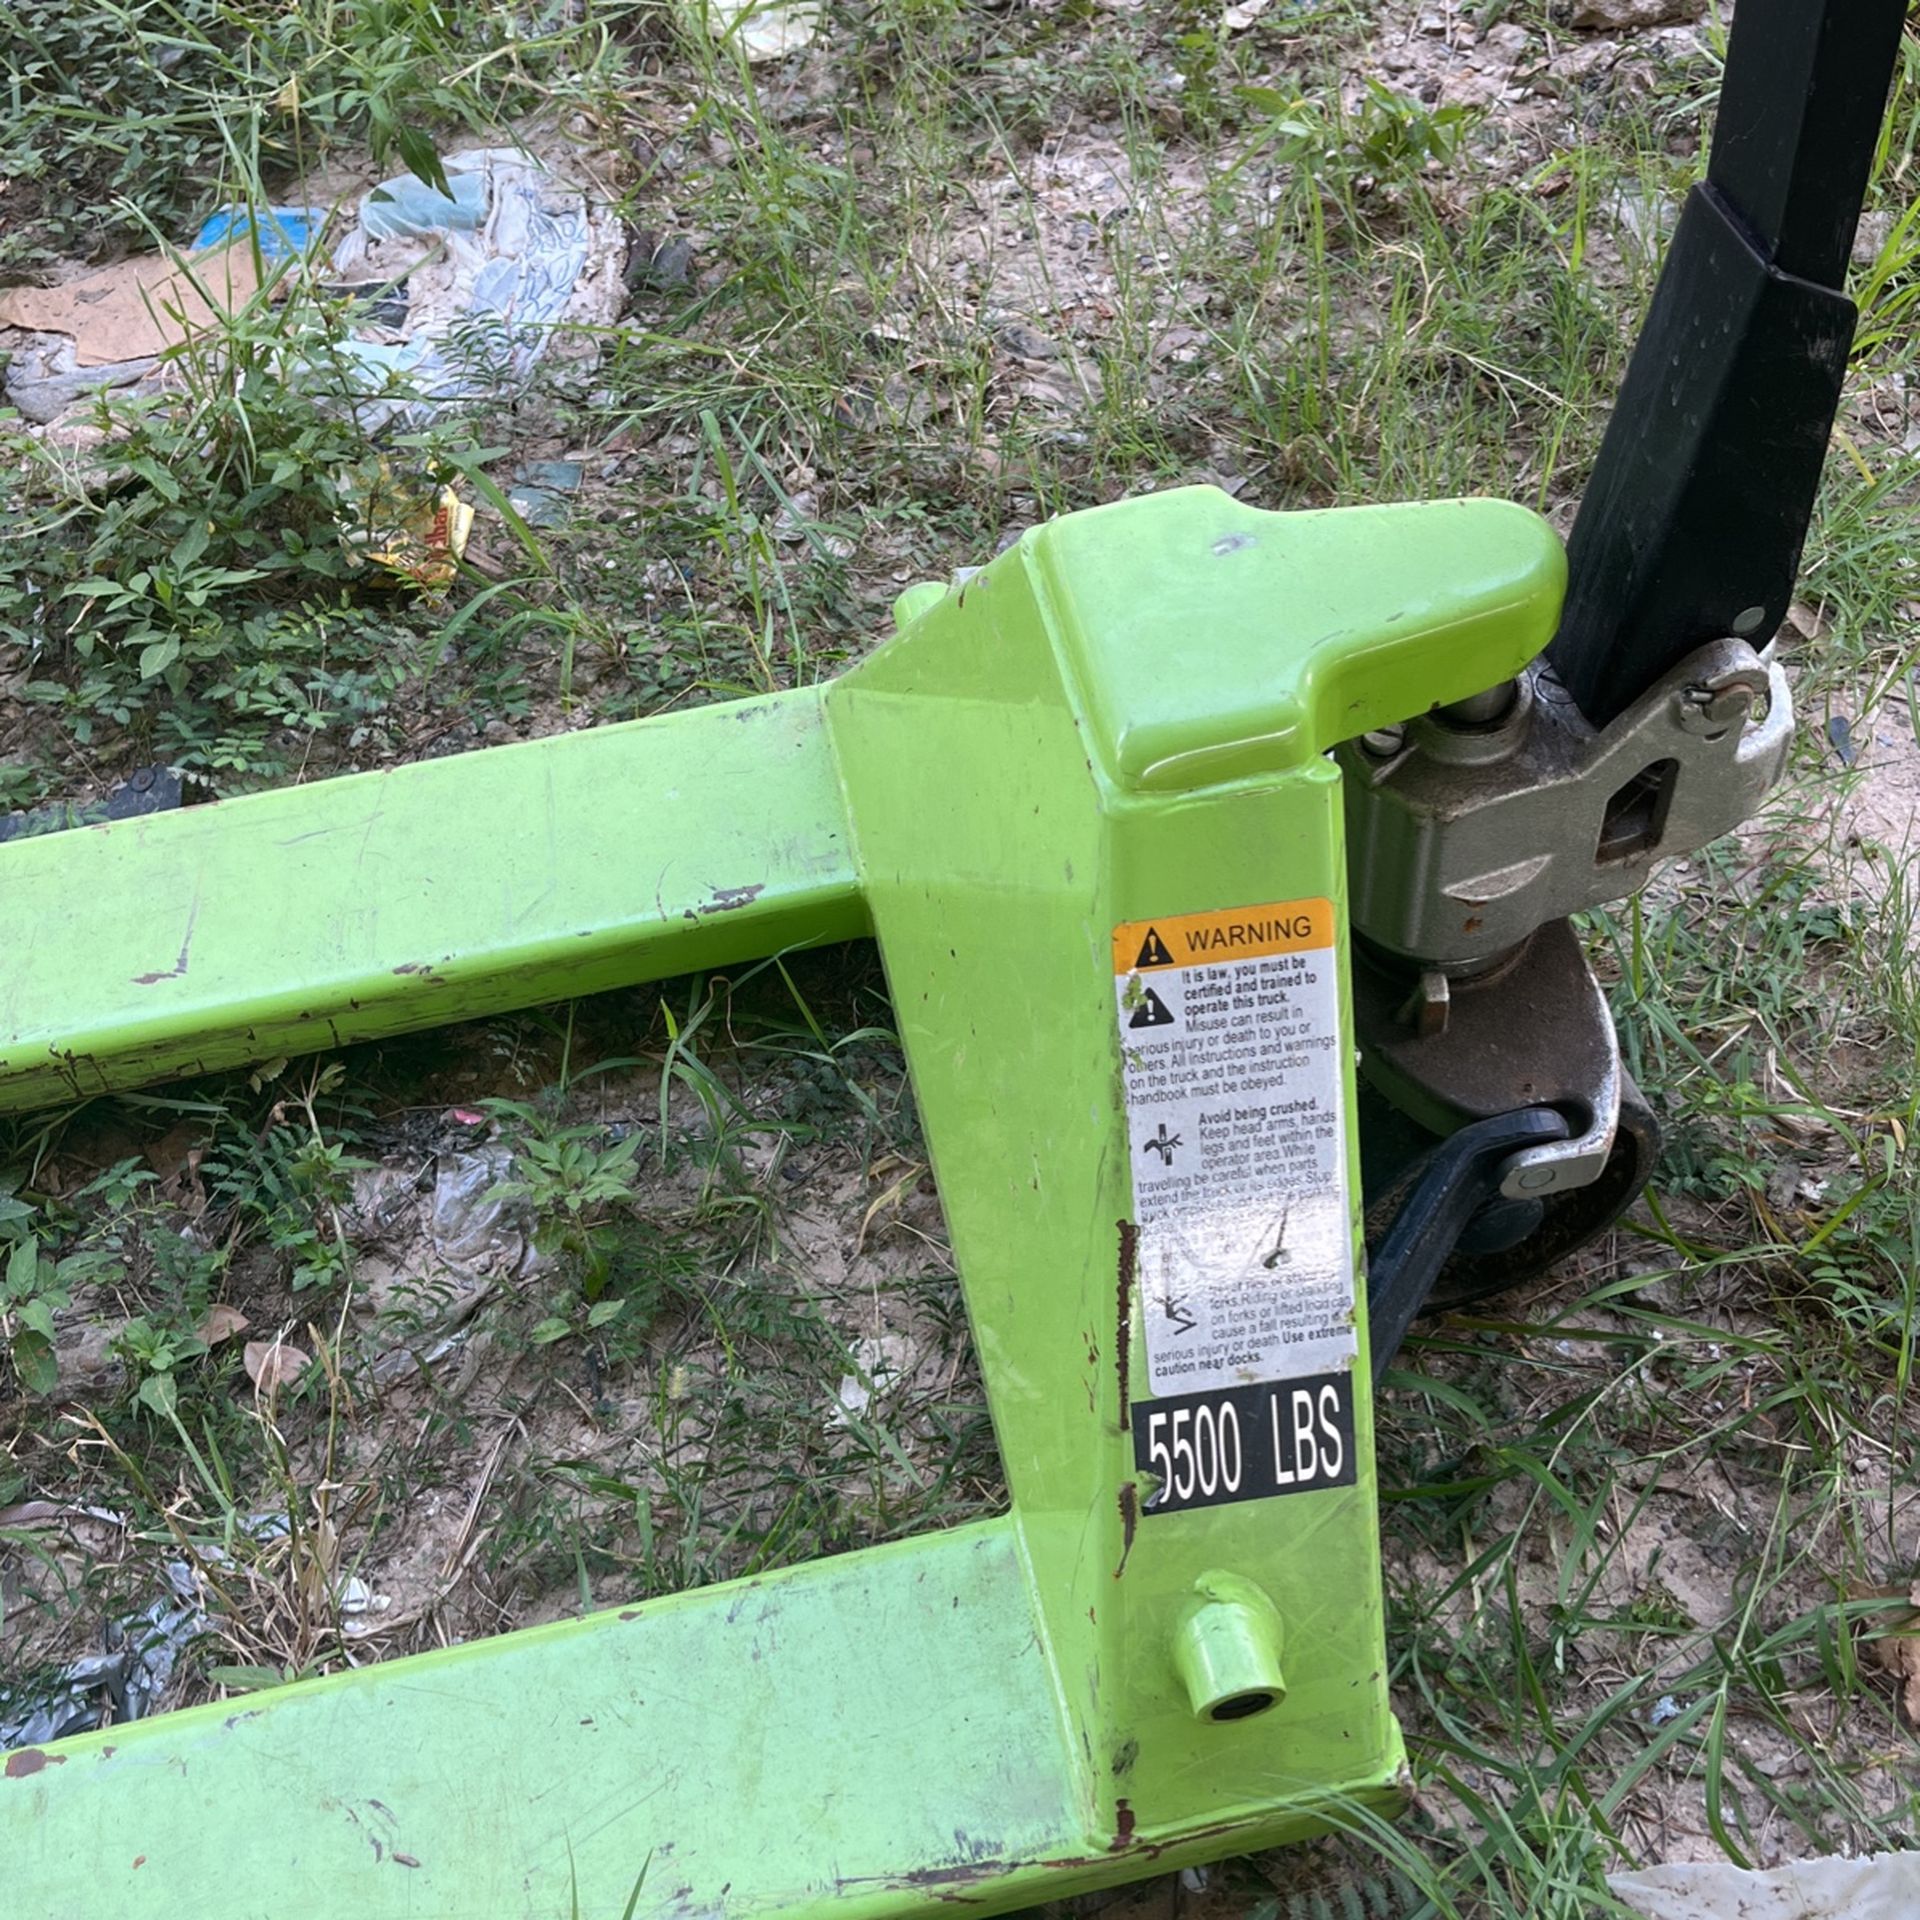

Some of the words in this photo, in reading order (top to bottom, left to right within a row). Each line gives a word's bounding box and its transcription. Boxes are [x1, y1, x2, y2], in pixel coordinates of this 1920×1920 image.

[1186, 916, 1312, 951] WARNING
[1182, 971, 1190, 984] It
[1193, 969, 1203, 982] is
[1235, 965, 1256, 980] you
[1259, 959, 1289, 972] must
[1292, 956, 1306, 968] be
[1184, 981, 1232, 1000] certified
[1236, 979, 1257, 994] and
[1261, 972, 1301, 991] trained
[1305, 972, 1317, 984] to
[1185, 997, 1230, 1017] operate
[1233, 994, 1254, 1008] this
[1258, 991, 1290, 1006] truck.
[1185, 1016, 1228, 1032] Misuse
[1231, 1014, 1252, 1028] can
[1256, 1008, 1289, 1023] result
[1292, 1006, 1303, 1018] in
[1171, 1053, 1185, 1068] All
[1189, 1045, 1256, 1065] instructions
[1260, 1041, 1281, 1054] and
[1284, 1035, 1336, 1052] warnings
[1172, 1035, 1204, 1055] injury
[1207, 1033, 1219, 1046] or
[1224, 1029, 1255, 1046] death
[1259, 1027, 1271, 1039] to
[1275, 1025, 1296, 1041] you
[1300, 1022, 1311, 1033] or
[1130, 1076, 1145, 1089] on
[1149, 1073, 1167, 1086] the
[1170, 1068, 1199, 1083] truck
[1202, 1065, 1224, 1079] and
[1227, 1061, 1246, 1075] the
[1250, 1055, 1309, 1072] instruction
[1130, 1087, 1187, 1105] handbook
[1191, 1083, 1219, 1096] must
[1223, 1079, 1238, 1092] be
[1241, 1073, 1286, 1092] obeyed.
[1199, 1110, 1231, 1126] Avoid
[1235, 1106, 1266, 1123] being
[1270, 1098, 1319, 1115] crushed.
[1200, 1126, 1230, 1142] Keep
[1301, 1110, 1336, 1126] hands
[1201, 1142, 1224, 1156] legs
[1228, 1136, 1250, 1151] and
[1253, 1131, 1276, 1146] feet
[1279, 1129, 1312, 1144] within
[1315, 1127, 1334, 1139] the
[1201, 1152, 1250, 1170] operator
[1283, 1143, 1316, 1159] While
[1138, 1174, 1191, 1195] travelling
[1194, 1171, 1210, 1185] be
[1212, 1165, 1251, 1183] careful
[1255, 1162, 1286, 1177] when
[1290, 1158, 1318, 1175] parts
[1140, 1191, 1178, 1208] extend
[1281, 1288, 1293, 1300] or
[1211, 1314, 1226, 1325] on
[1228, 1310, 1256, 1322] forks
[1260, 1307, 1271, 1317] or
[1275, 1301, 1302, 1316] lifted
[1332, 1296, 1351, 1307] can
[1212, 1325, 1246, 1340] cause
[1250, 1323, 1257, 1334] a
[1259, 1318, 1277, 1333] fall
[1280, 1314, 1328, 1330] resulting
[1154, 1345, 1194, 1363] serious
[1198, 1340, 1229, 1360] injury
[1233, 1340, 1244, 1350] or
[1283, 1330, 1304, 1344] Use
[1308, 1324, 1352, 1341] extreme
[1155, 1359, 1196, 1377] caution
[1199, 1357, 1224, 1372] near
[1227, 1352, 1264, 1367] docks.
[1149, 1401, 1241, 1503] 5500
[1271, 1384, 1343, 1484] LBS
